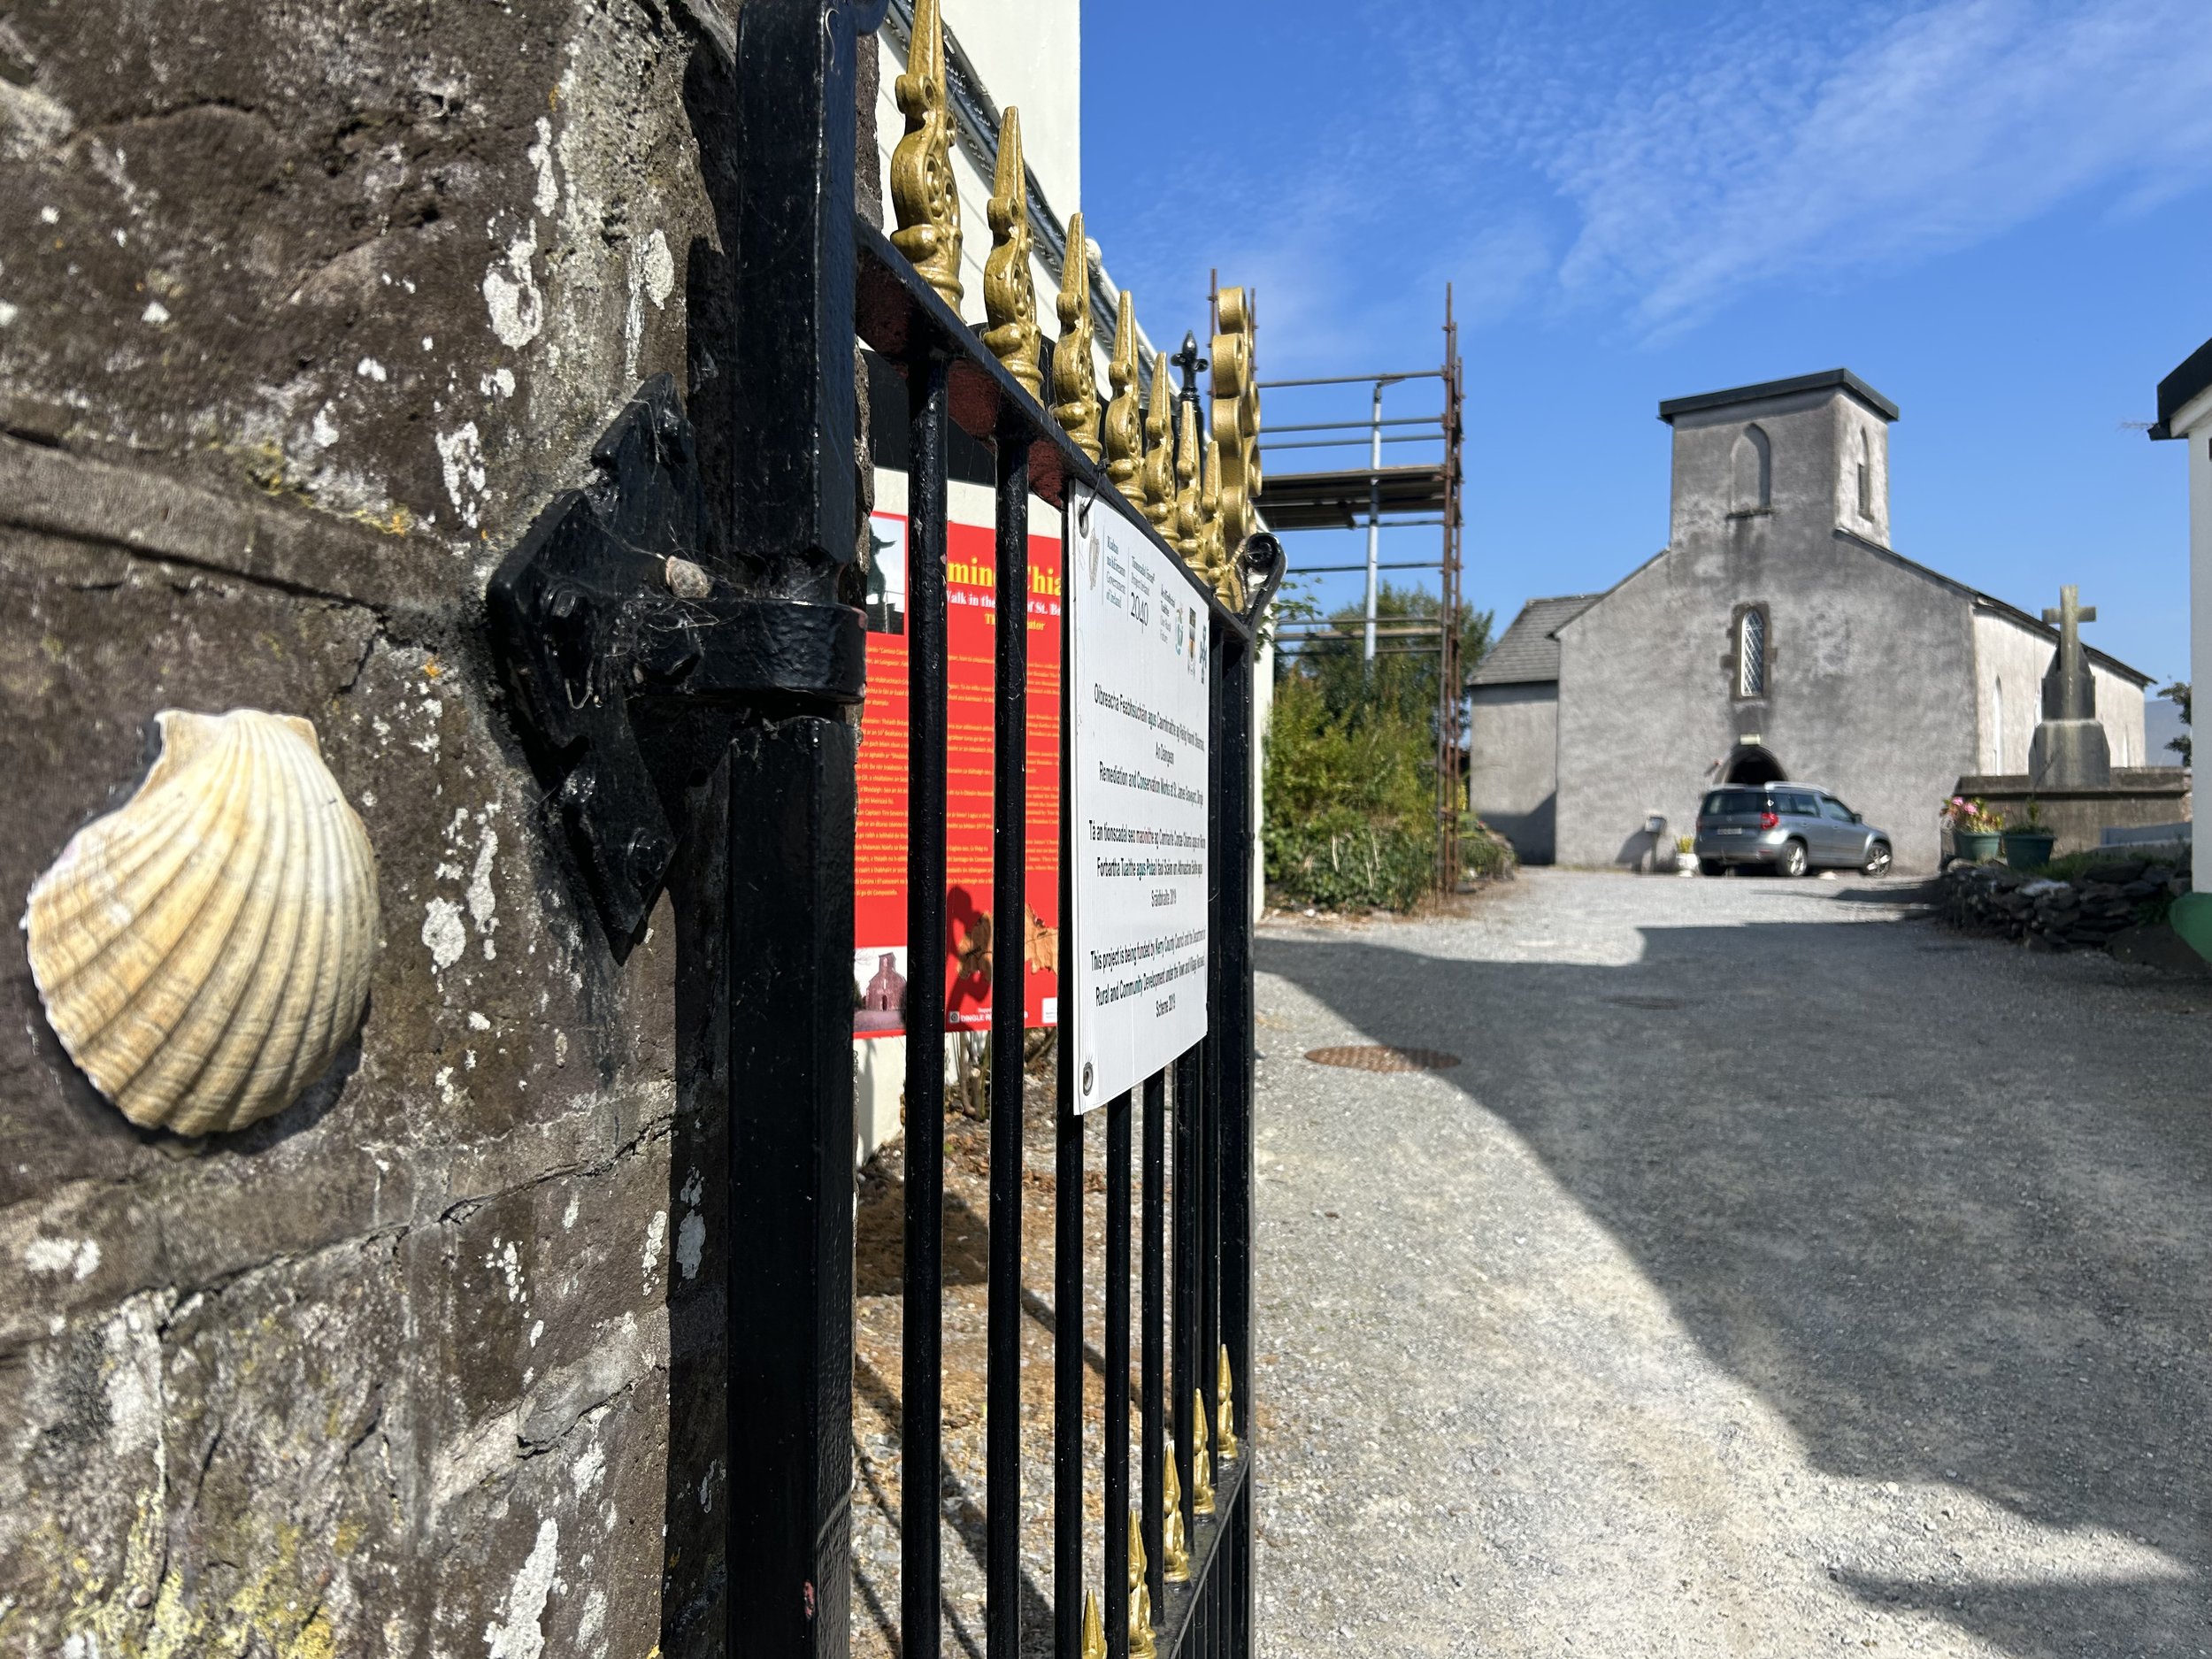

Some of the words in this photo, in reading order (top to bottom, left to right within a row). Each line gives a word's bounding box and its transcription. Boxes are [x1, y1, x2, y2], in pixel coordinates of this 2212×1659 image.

[947, 557, 996, 588] min
[1107, 571, 1125, 594] Government
[969, 594, 979, 607] in
[980, 595, 996, 609] the
[1034, 602, 1048, 615] St.
[1131, 592, 1148, 634] 2040
[1094, 683, 1118, 711] Oibreacha
[1156, 742, 1160, 759] An
[1100, 761, 1128, 787] Remediation
[1137, 771, 1160, 794] Conservation
[1161, 778, 1170, 796] Works
[1089, 820, 1096, 841] Tá
[1097, 826, 1103, 841] an
[1103, 822, 1128, 842] tionscadal
[1097, 857, 1120, 877] Forbartha
[1137, 863, 1146, 881] agus
[1090, 949, 1102, 972] This
[1102, 947, 1119, 974] project
[1120, 945, 1125, 964] is
[1125, 943, 1136, 966] being
[1137, 941, 1150, 960] funded
[1150, 939, 1155, 961] by
[1156, 937, 1164, 958] Kerry
[1164, 935, 1175, 955] County
[1095, 983, 1110, 1007] Rural
[1119, 975, 1142, 998] Community
[1143, 967, 1165, 991] Development
[960, 1014, 983, 1023] DINGLE
[1156, 1000, 1169, 1018] Scheme
